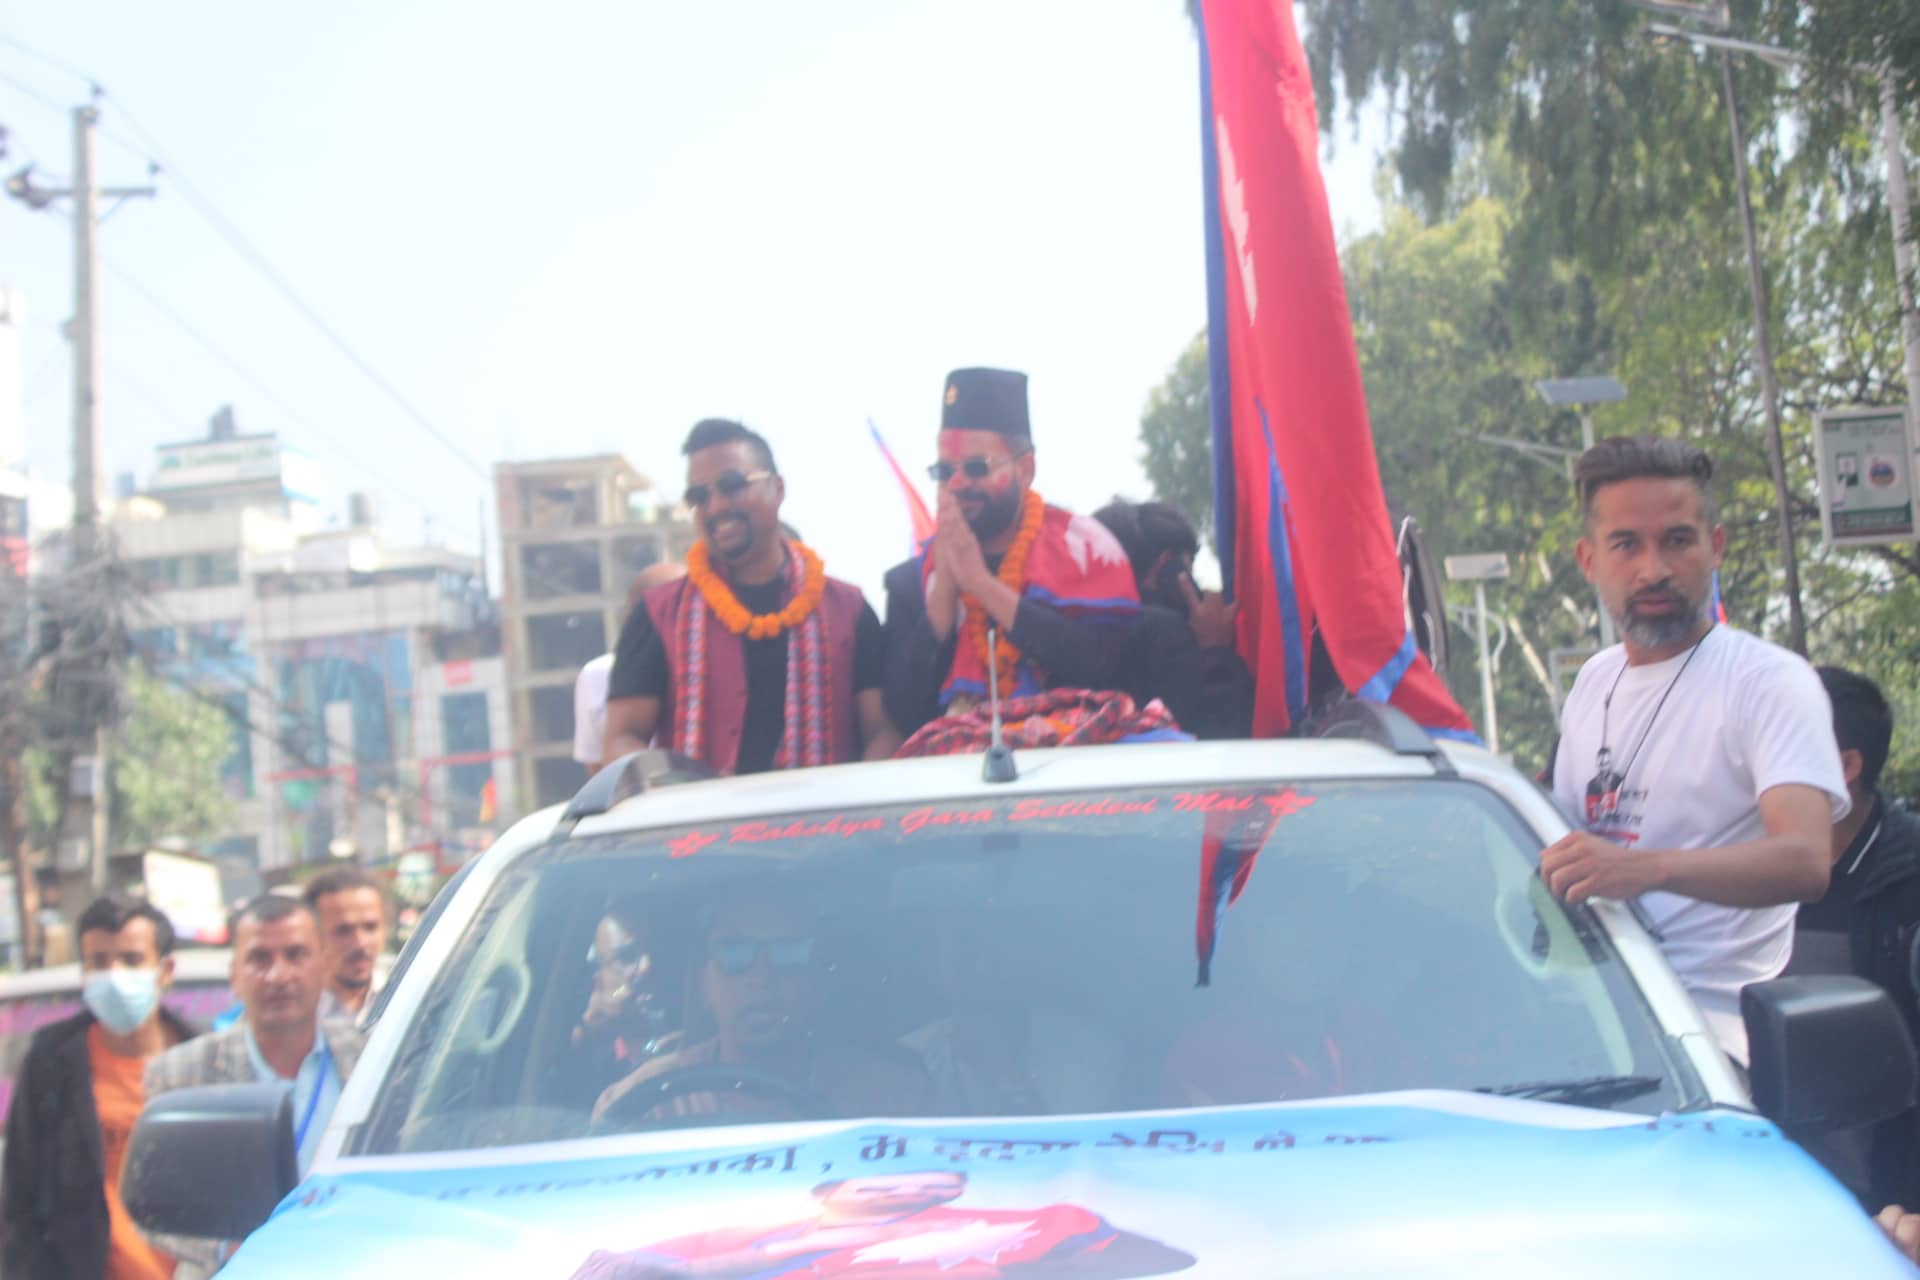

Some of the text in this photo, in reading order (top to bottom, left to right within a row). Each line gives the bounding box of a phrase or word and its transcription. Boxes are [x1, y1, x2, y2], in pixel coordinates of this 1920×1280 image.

[898, 806, 993, 835] Gara
[1007, 796, 1160, 821] Setidevi
[1171, 791, 1255, 812] Mai
